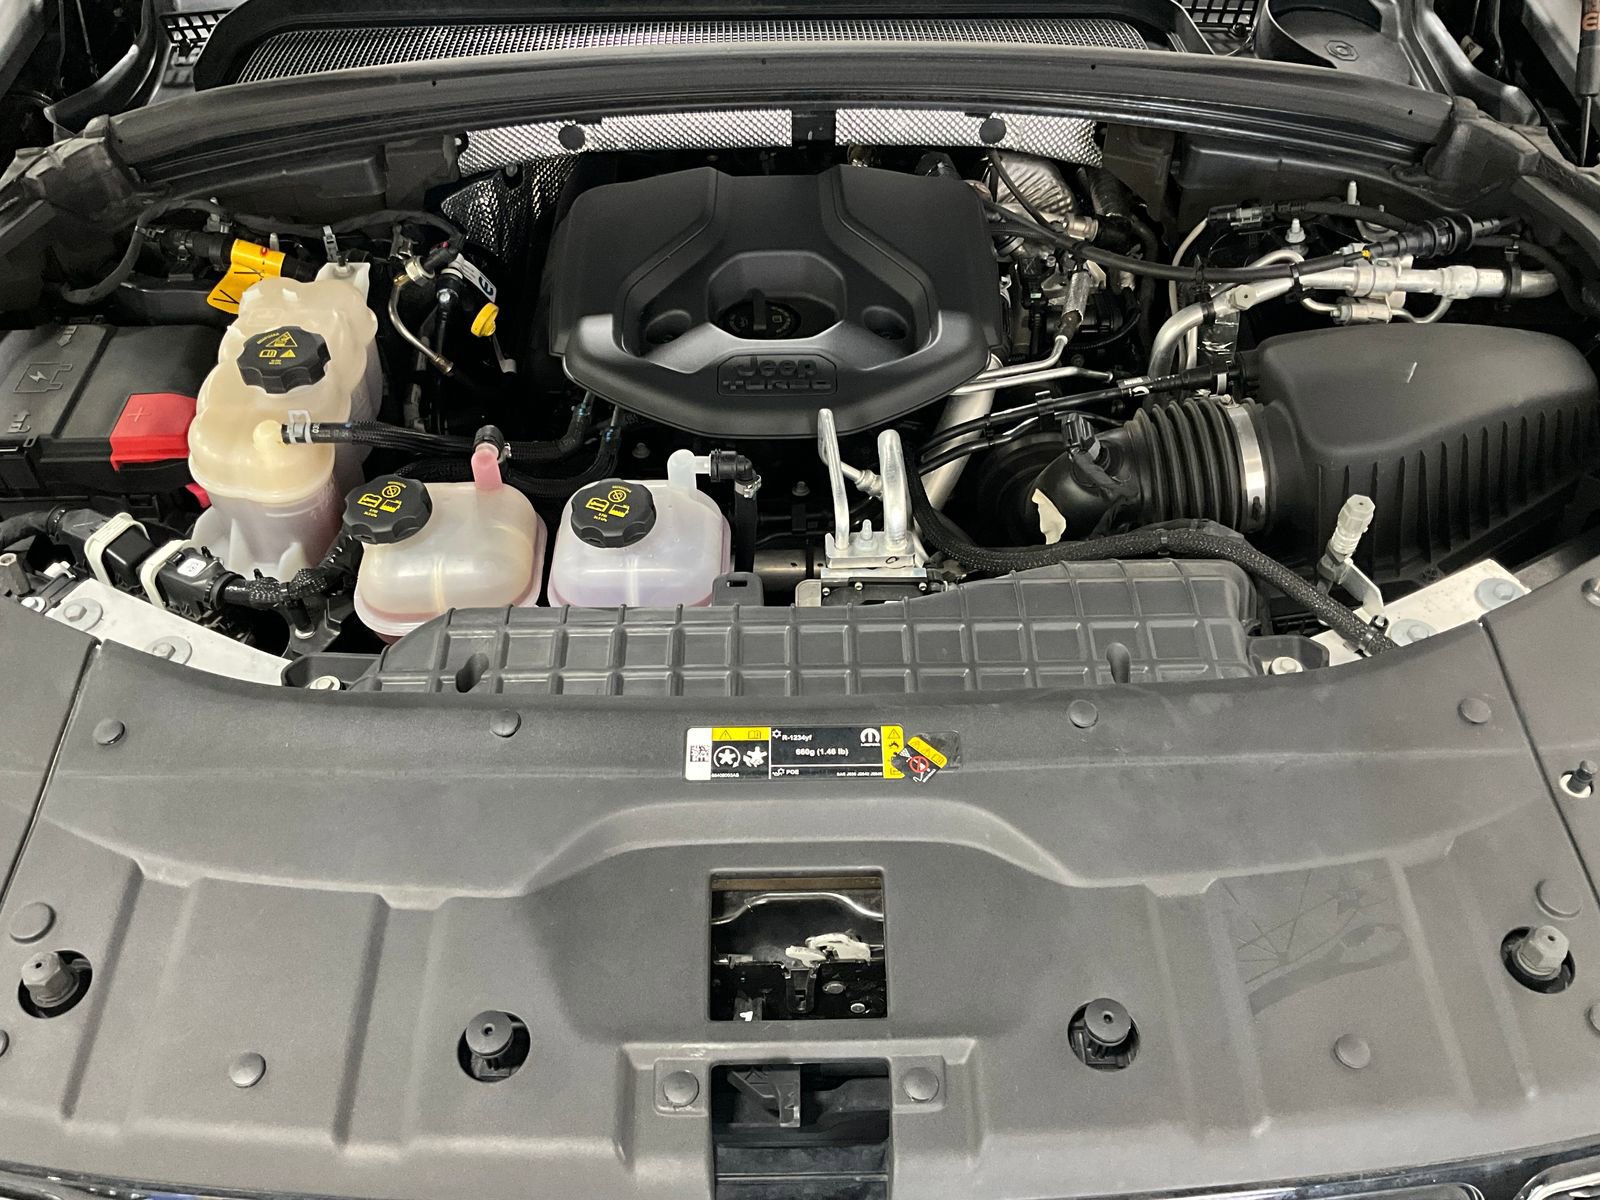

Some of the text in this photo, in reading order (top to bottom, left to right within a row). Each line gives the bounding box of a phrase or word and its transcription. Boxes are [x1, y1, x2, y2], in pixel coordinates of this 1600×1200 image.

[737, 353, 816, 378] Jeep
[781, 734, 813, 742] R-1234yf
[837, 748, 849, 757] lb)
